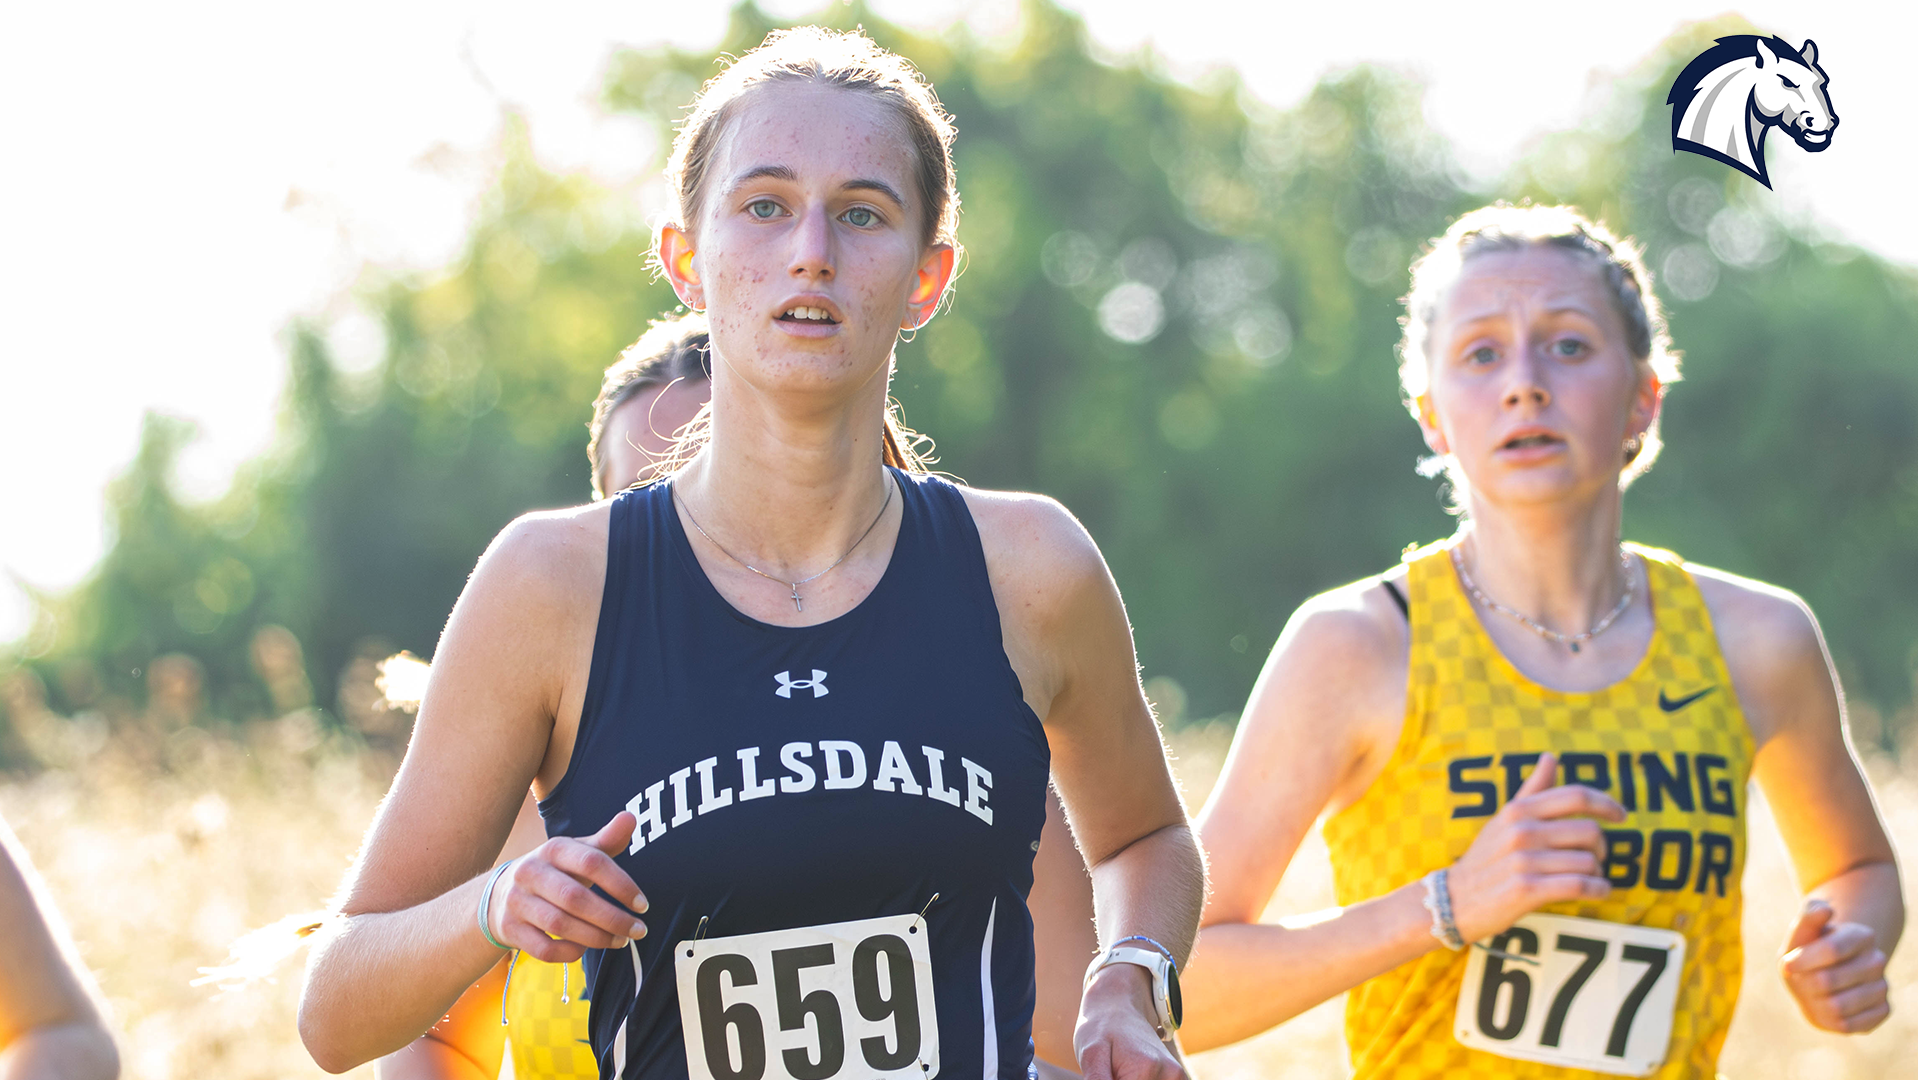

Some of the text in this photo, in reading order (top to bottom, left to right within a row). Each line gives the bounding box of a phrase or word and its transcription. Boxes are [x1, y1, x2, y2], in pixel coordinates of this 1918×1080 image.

[625, 740, 993, 856] HILLSDALE
[695, 934, 921, 1080] 659
[1477, 926, 1669, 1058] 677
